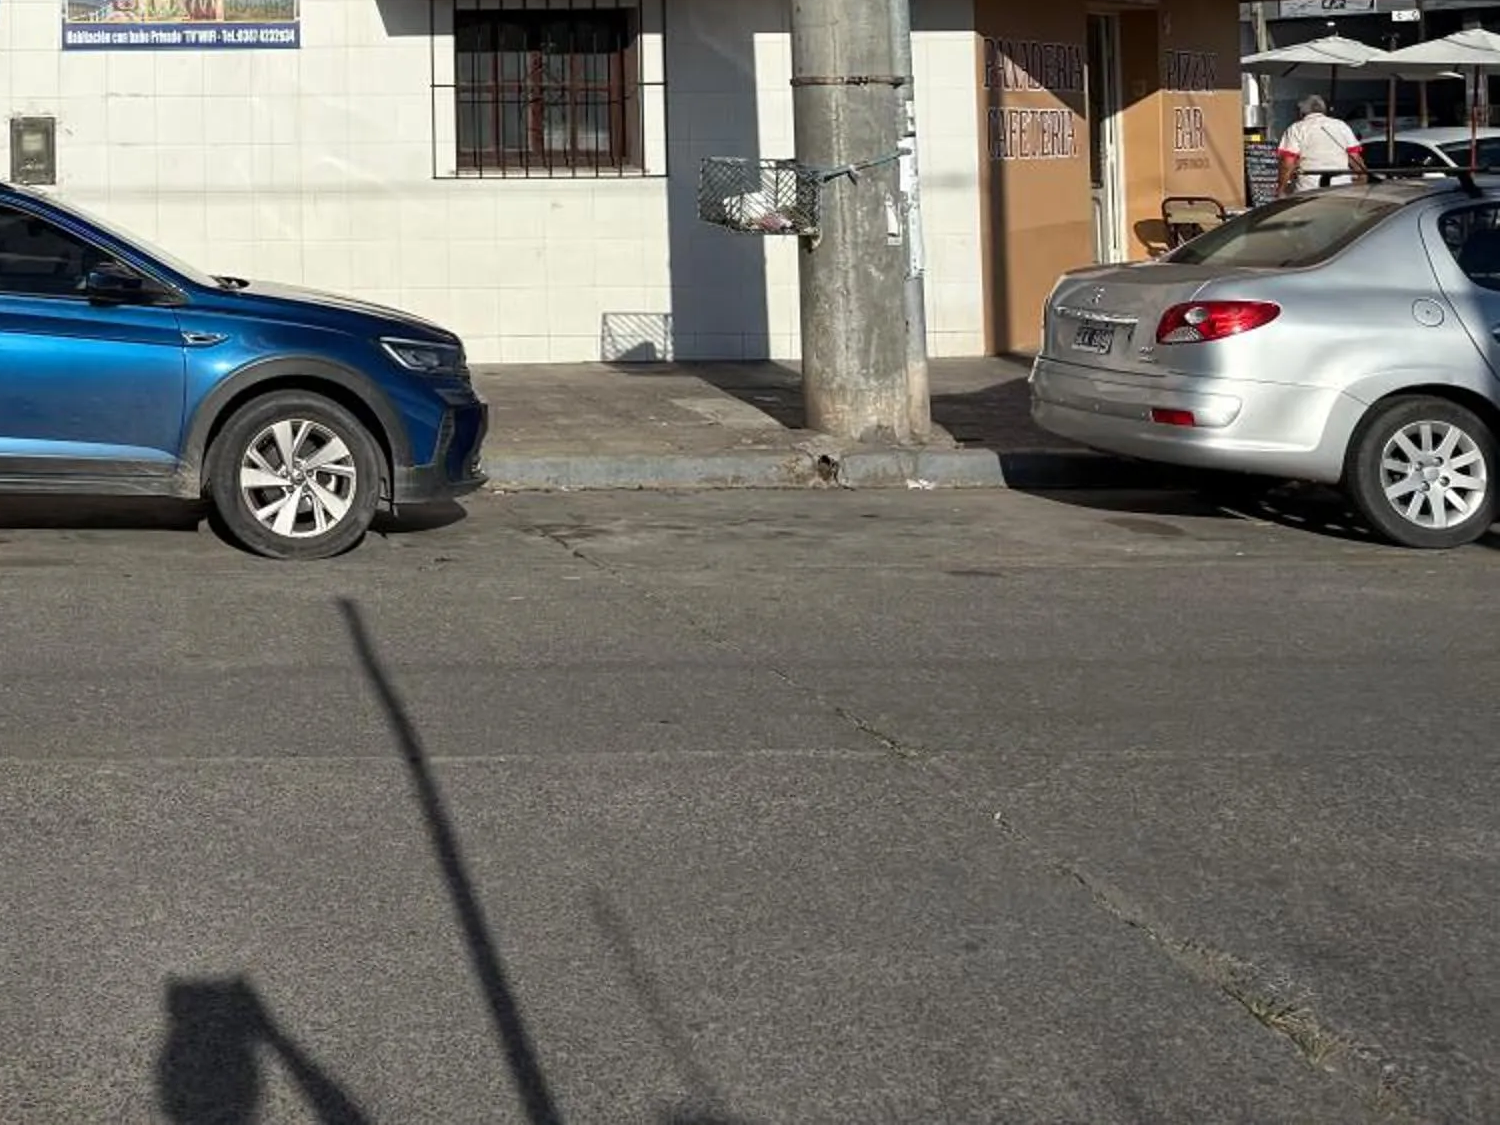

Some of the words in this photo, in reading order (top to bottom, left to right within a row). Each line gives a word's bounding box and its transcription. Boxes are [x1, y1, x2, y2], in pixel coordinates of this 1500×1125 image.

[983, 37, 1086, 91] PANADERIA
[986, 106, 1079, 159] CAFETERIA
[1173, 105, 1206, 153] BAR
